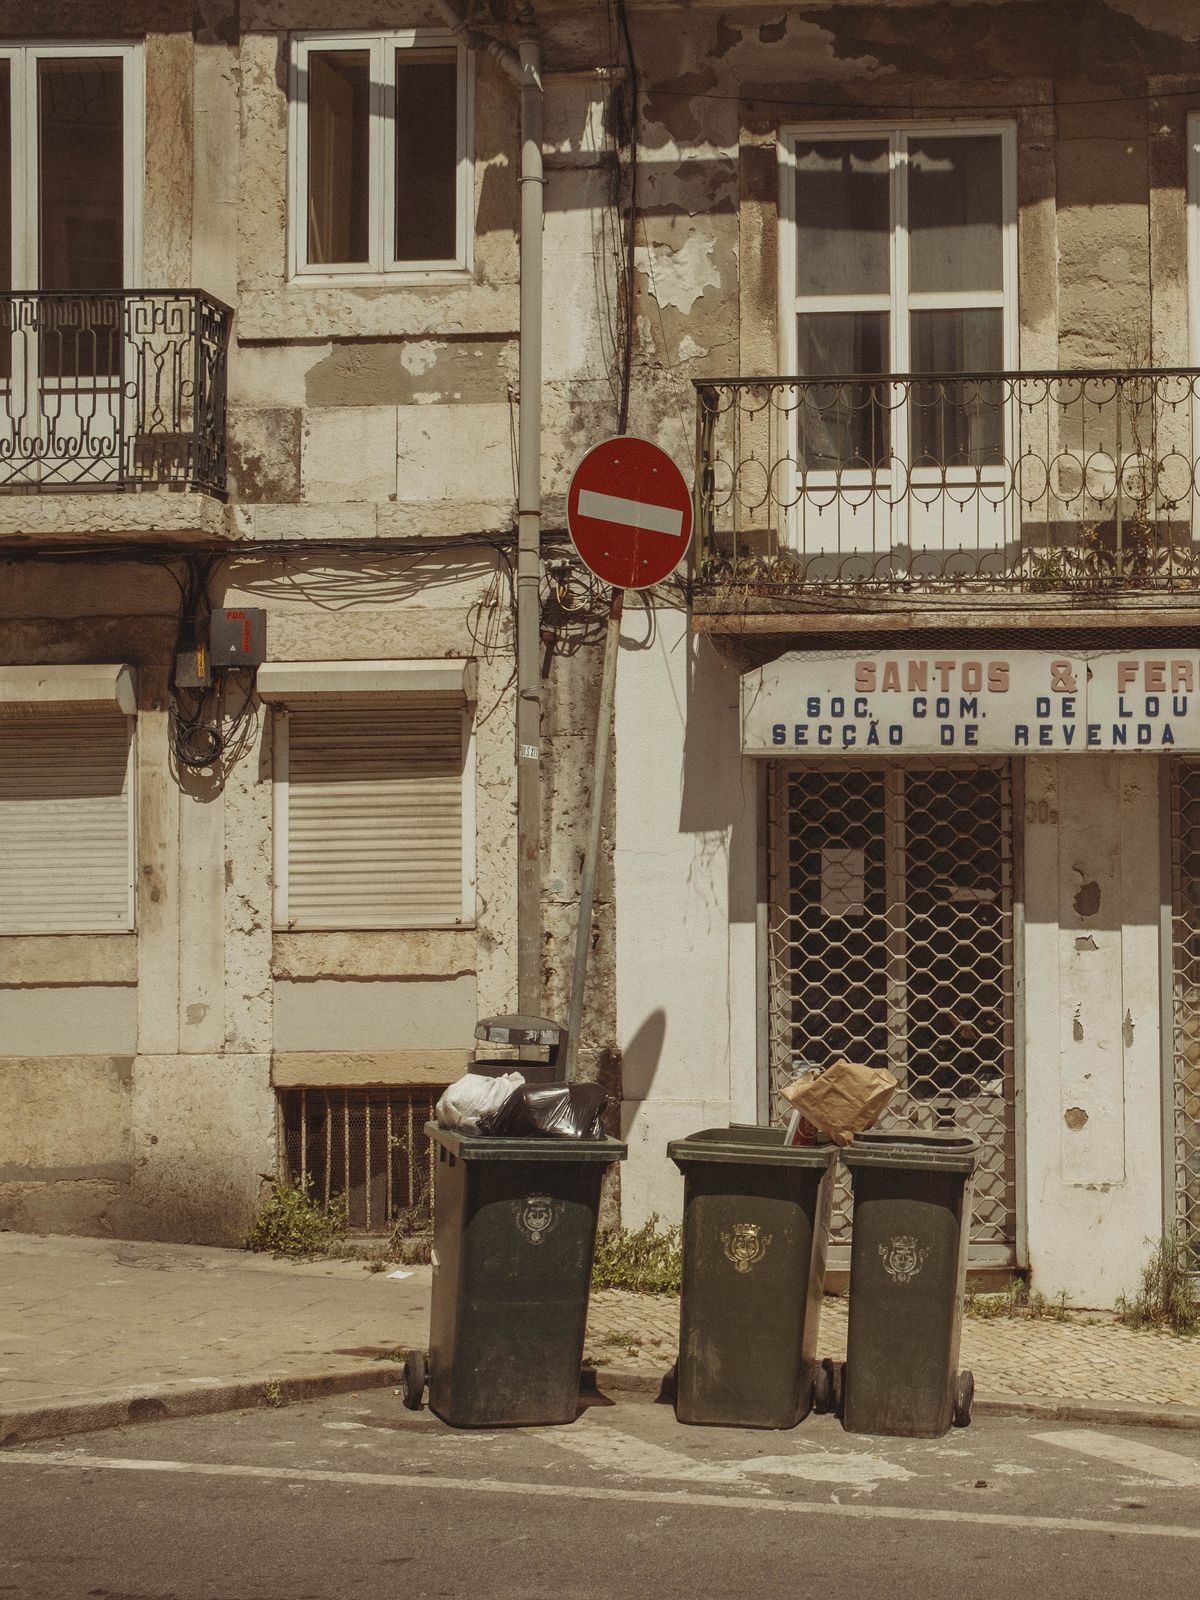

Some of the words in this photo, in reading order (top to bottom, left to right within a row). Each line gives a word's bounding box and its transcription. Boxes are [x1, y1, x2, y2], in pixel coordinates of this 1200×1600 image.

[854, 660, 1010, 693] SANTOS
[1050, 660, 1078, 693] &
[806, 697, 873, 718] SOC.
[912, 697, 986, 718] COM.
[1036, 697, 1076, 718] DE
[772, 719, 903, 750] SECÇÃO
[940, 724, 979, 746] DE
[1014, 723, 1175, 746] REVENDA
